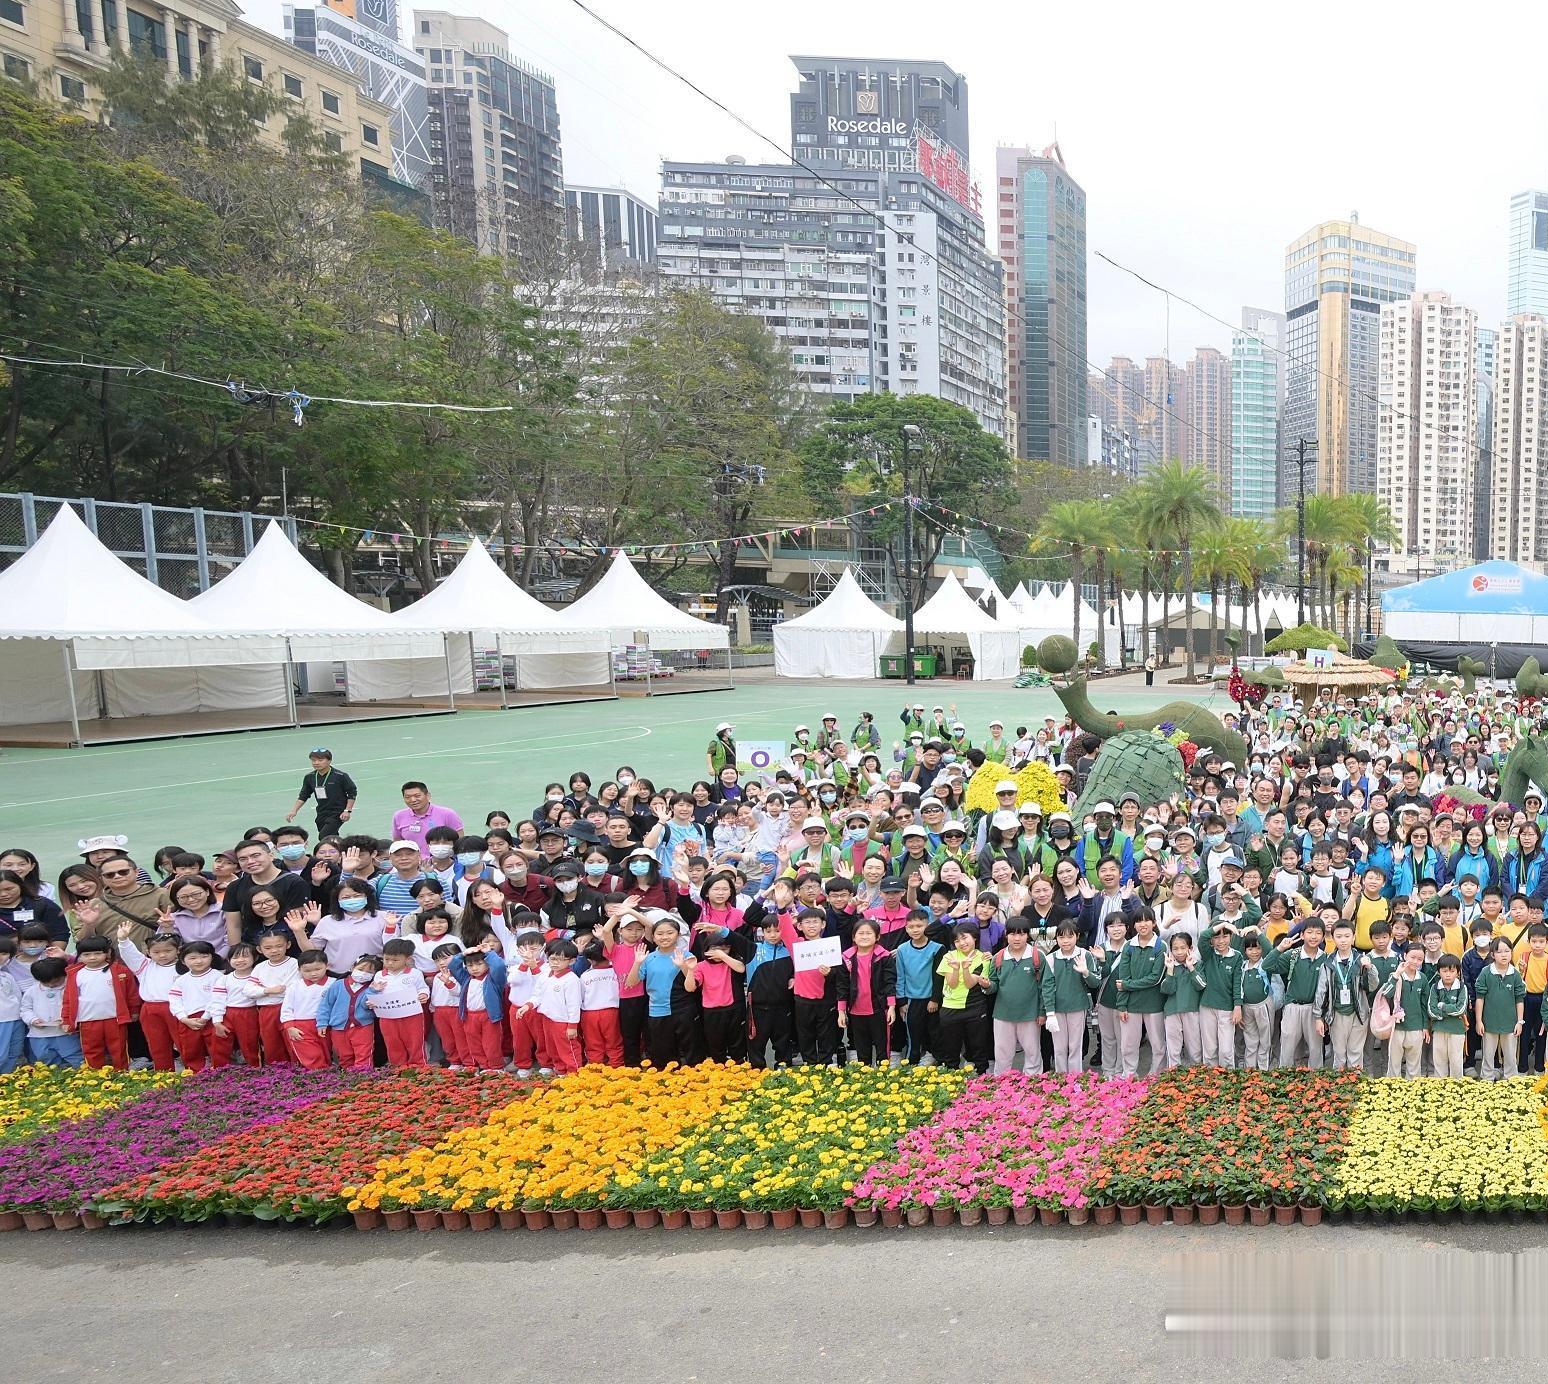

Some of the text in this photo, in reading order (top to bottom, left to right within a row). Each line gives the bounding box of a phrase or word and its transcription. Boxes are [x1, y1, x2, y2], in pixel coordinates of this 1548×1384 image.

[351, 31, 406, 69] Rosedale
[827, 116, 908, 135] Rosedale
[1314, 655, 1324, 668] H
[750, 750, 770, 768] O
